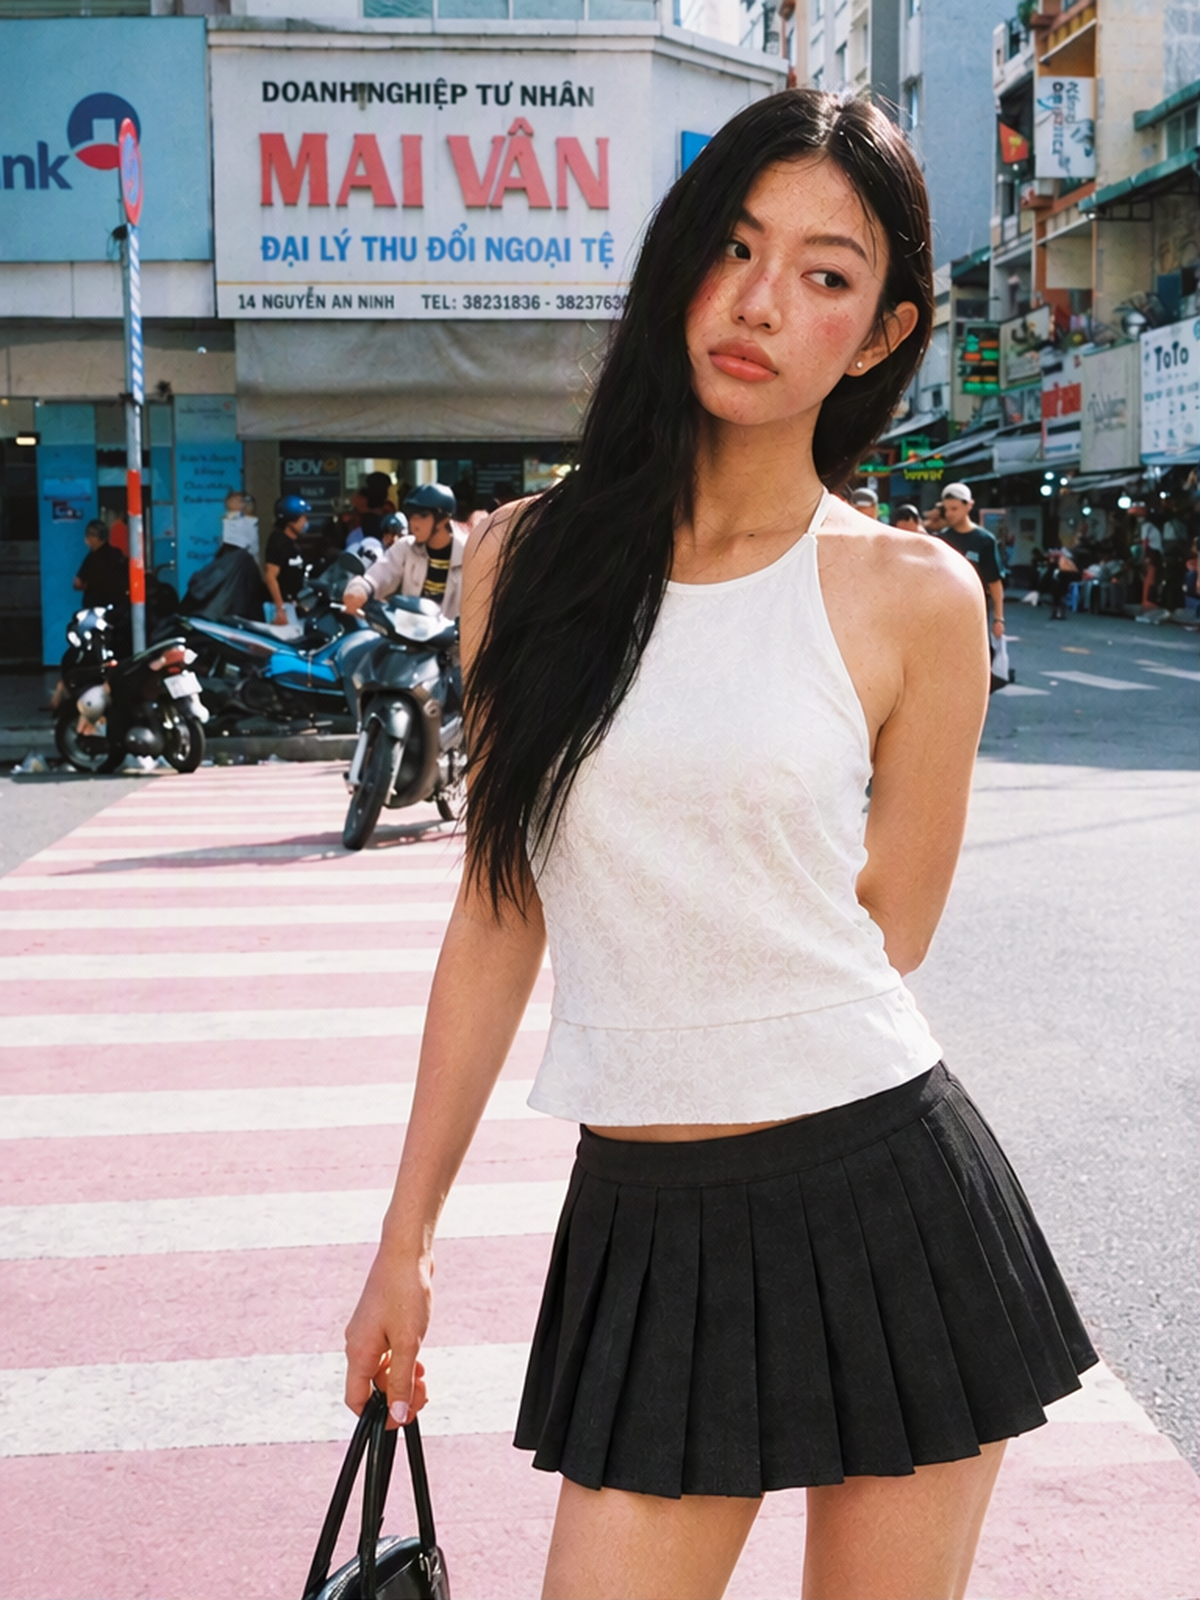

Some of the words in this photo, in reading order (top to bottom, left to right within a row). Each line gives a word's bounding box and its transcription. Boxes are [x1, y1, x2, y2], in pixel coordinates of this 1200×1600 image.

[261, 80, 356, 104] DOANH
[365, 77, 468, 111] NGHIỆP
[475, 81, 514, 106] TƯ
[520, 80, 594, 107] NHÂN
[260, 133, 423, 206] MAI
[448, 117, 609, 209] VÂN
[260, 234, 311, 269] ĐẠI
[319, 228, 353, 263] LÝ
[360, 235, 418, 263] THU
[425, 222, 477, 263] ĐỔI
[484, 236, 572, 269] NGOẠI
[580, 230, 615, 269] TỆ
[238, 294, 256, 310] 14
[262, 286, 327, 310] NGUYỄN
[331, 294, 353, 310] AN
[357, 294, 395, 310] NINH
[421, 294, 457, 310] TEL:
[462, 294, 541, 310] 38231836
